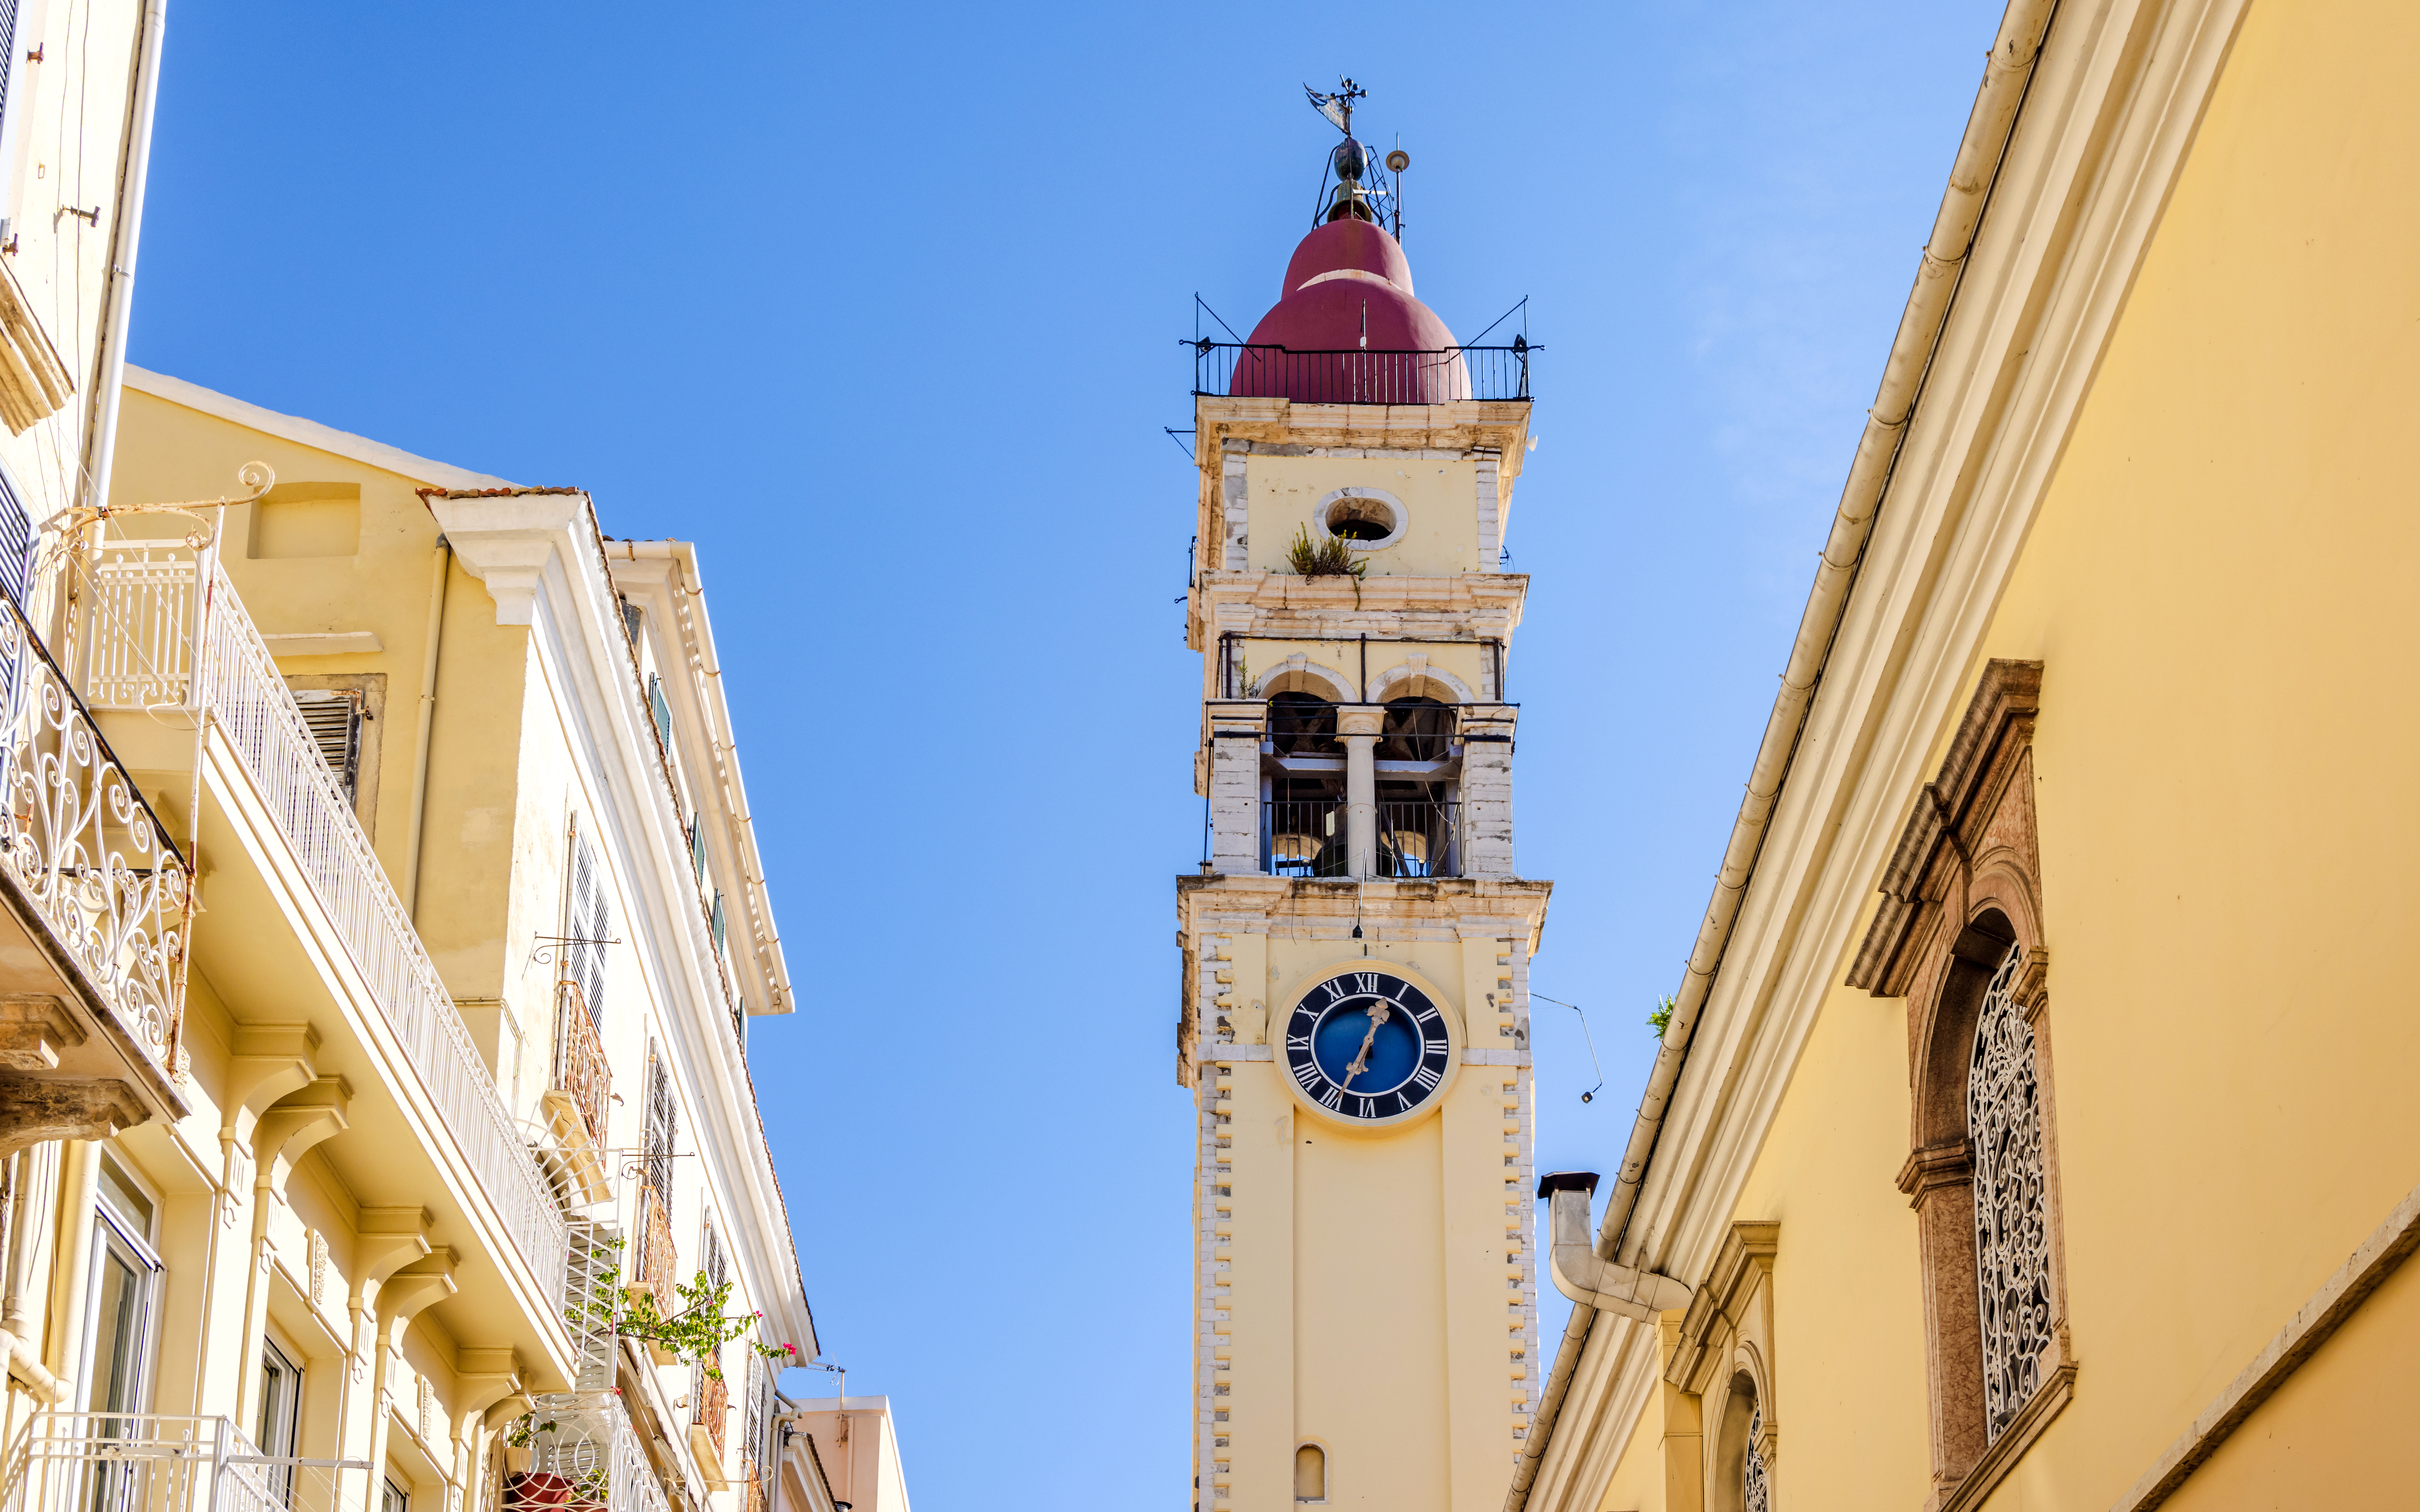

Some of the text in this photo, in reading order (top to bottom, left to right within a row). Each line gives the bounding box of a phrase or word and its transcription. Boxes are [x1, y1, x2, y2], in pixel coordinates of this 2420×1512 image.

[1321, 979, 1345, 1002] XI
[1354, 973, 1378, 993] XII
[1395, 983, 1409, 1001] I
[1296, 1004, 1319, 1022] X
[1416, 1007, 1439, 1023] II
[1288, 1034, 1309, 1050] IX
[1426, 1039, 1447, 1055] III
[1293, 1061, 1322, 1092] VIII
[1413, 1065, 1441, 1092] IIII
[1318, 1086, 1344, 1111] VII
[1359, 1098, 1376, 1118] VI
[1397, 1091, 1413, 1111] V
